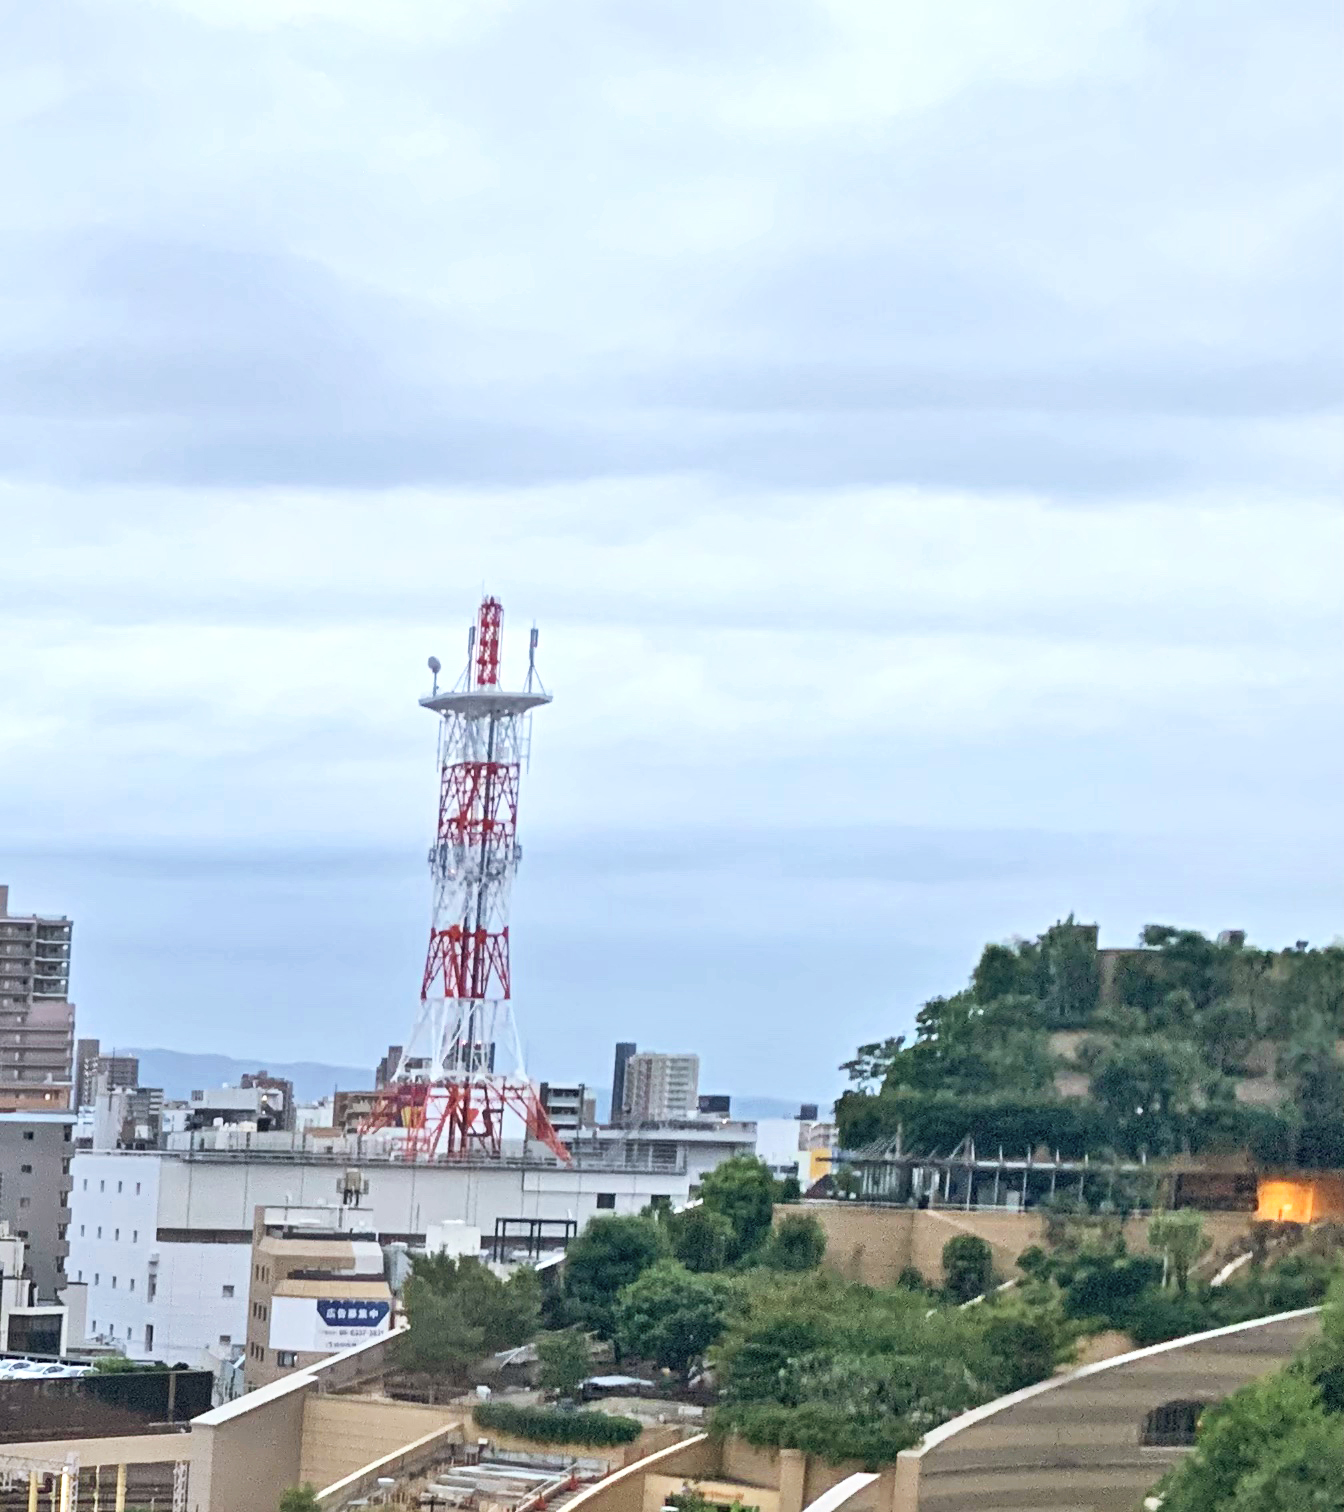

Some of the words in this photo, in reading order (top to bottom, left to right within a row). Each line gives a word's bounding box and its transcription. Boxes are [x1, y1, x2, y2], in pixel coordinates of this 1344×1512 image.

[326, 1308, 379, 1319] 広告募集中
